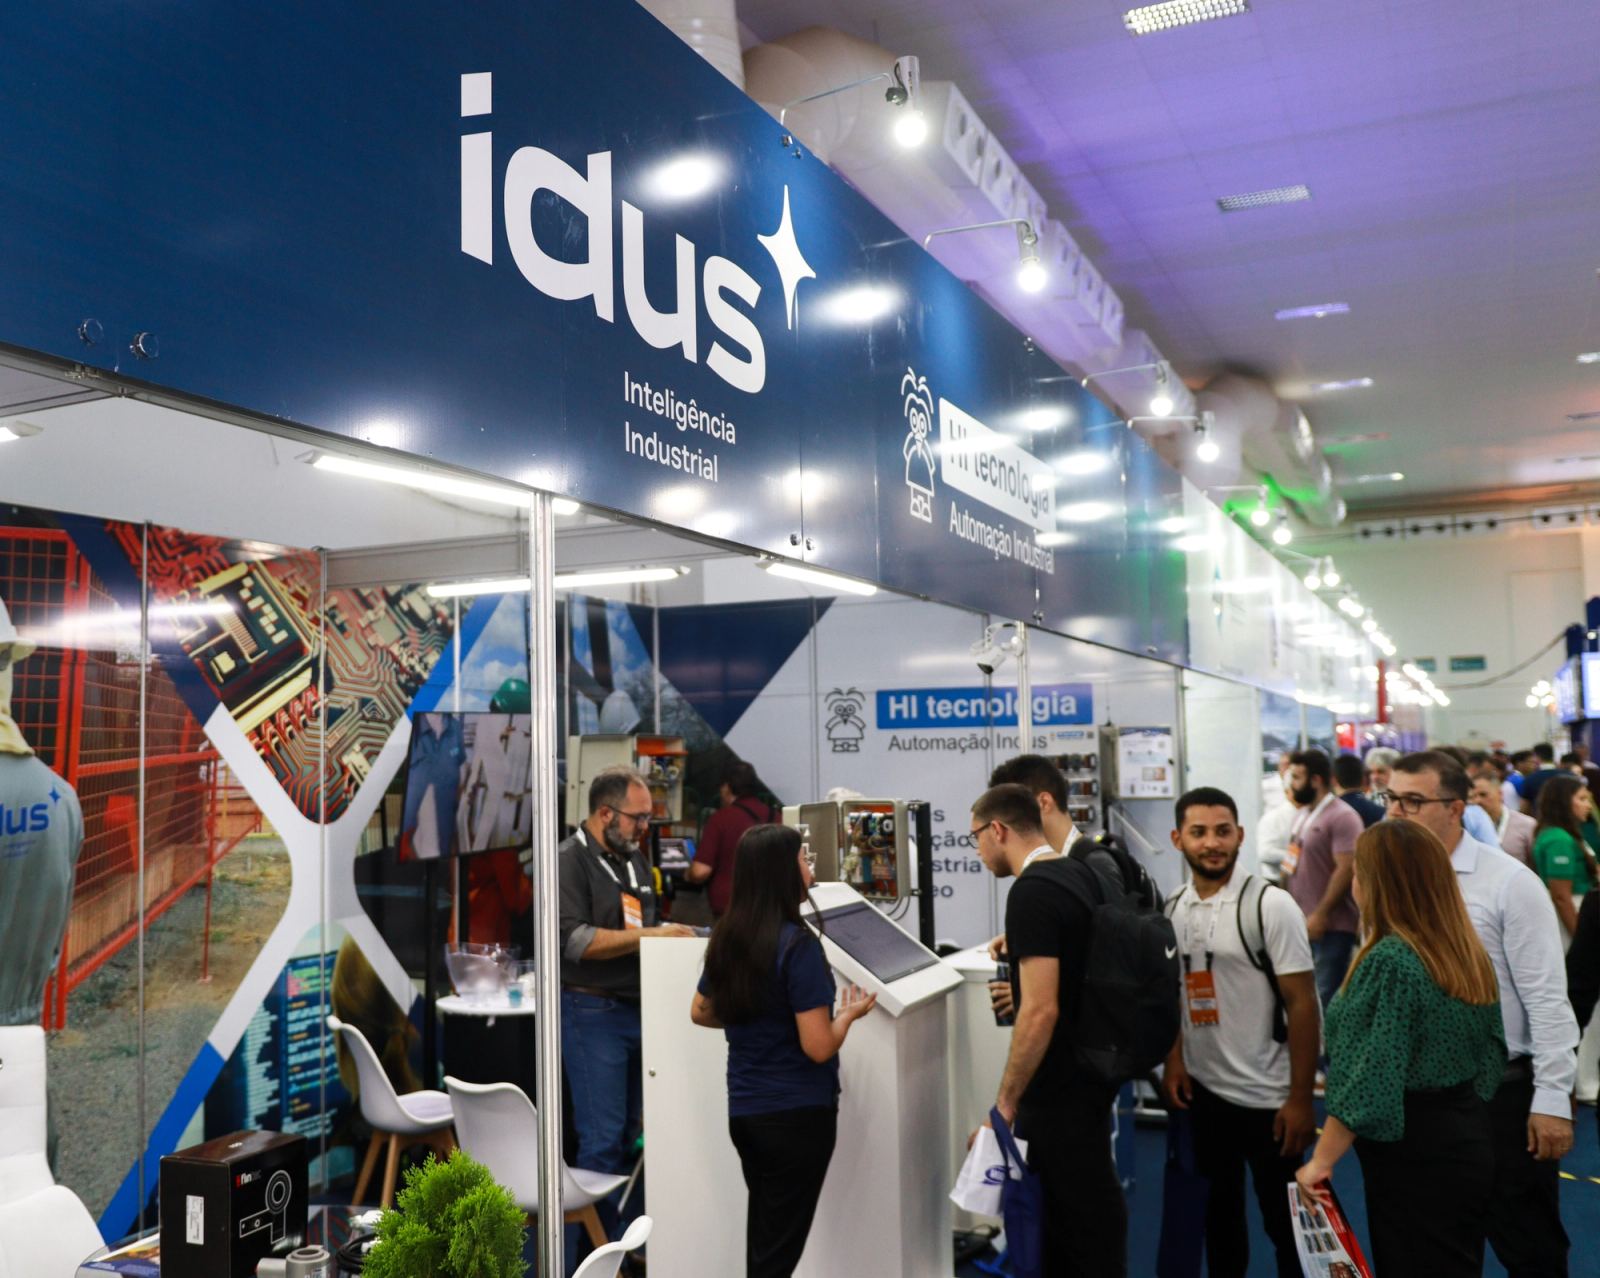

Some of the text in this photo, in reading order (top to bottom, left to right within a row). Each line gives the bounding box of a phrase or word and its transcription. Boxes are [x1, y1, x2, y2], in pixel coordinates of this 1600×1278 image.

[625, 371, 736, 445] Inteligência
[625, 421, 718, 482] Industrial
[950, 500, 1011, 560] Automação
[888, 694, 918, 720] HI
[888, 734, 990, 753] Automação
